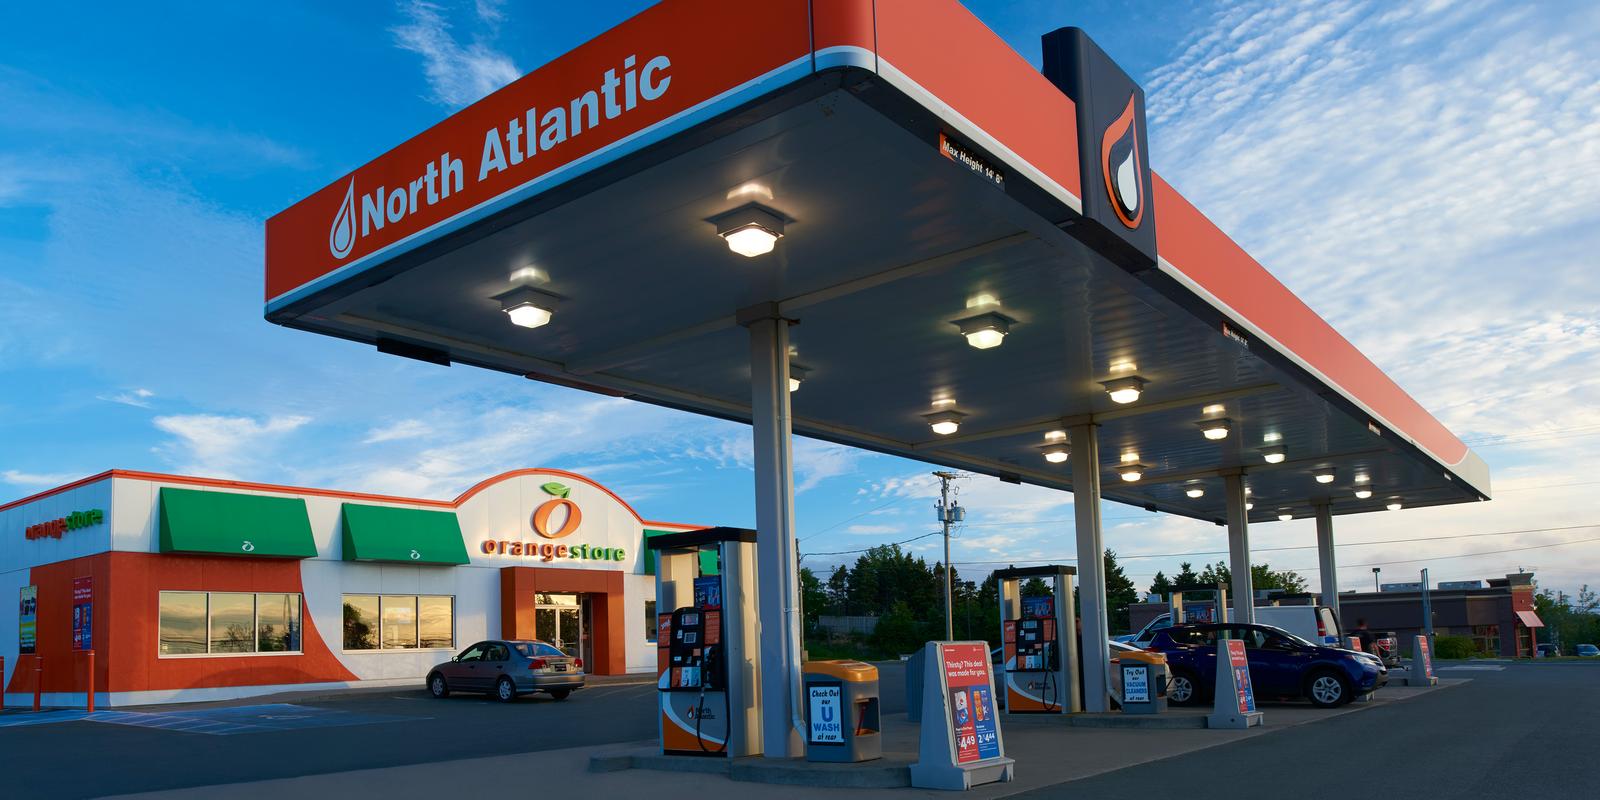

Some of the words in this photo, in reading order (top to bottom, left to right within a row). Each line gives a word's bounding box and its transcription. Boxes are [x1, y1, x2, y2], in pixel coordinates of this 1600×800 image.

[361, 152, 464, 237] North
[477, 53, 671, 183] Atlantic
[942, 140, 959, 158] Max
[960, 151, 983, 173] Height
[25, 510, 103, 541] orangestore
[481, 539, 626, 562] orangestore
[946, 660, 964, 669] Thirsty?
[964, 660, 973, 668] This
[829, 689, 839, 697] Out
[821, 706, 833, 722] U
[813, 723, 840, 731] WASH
